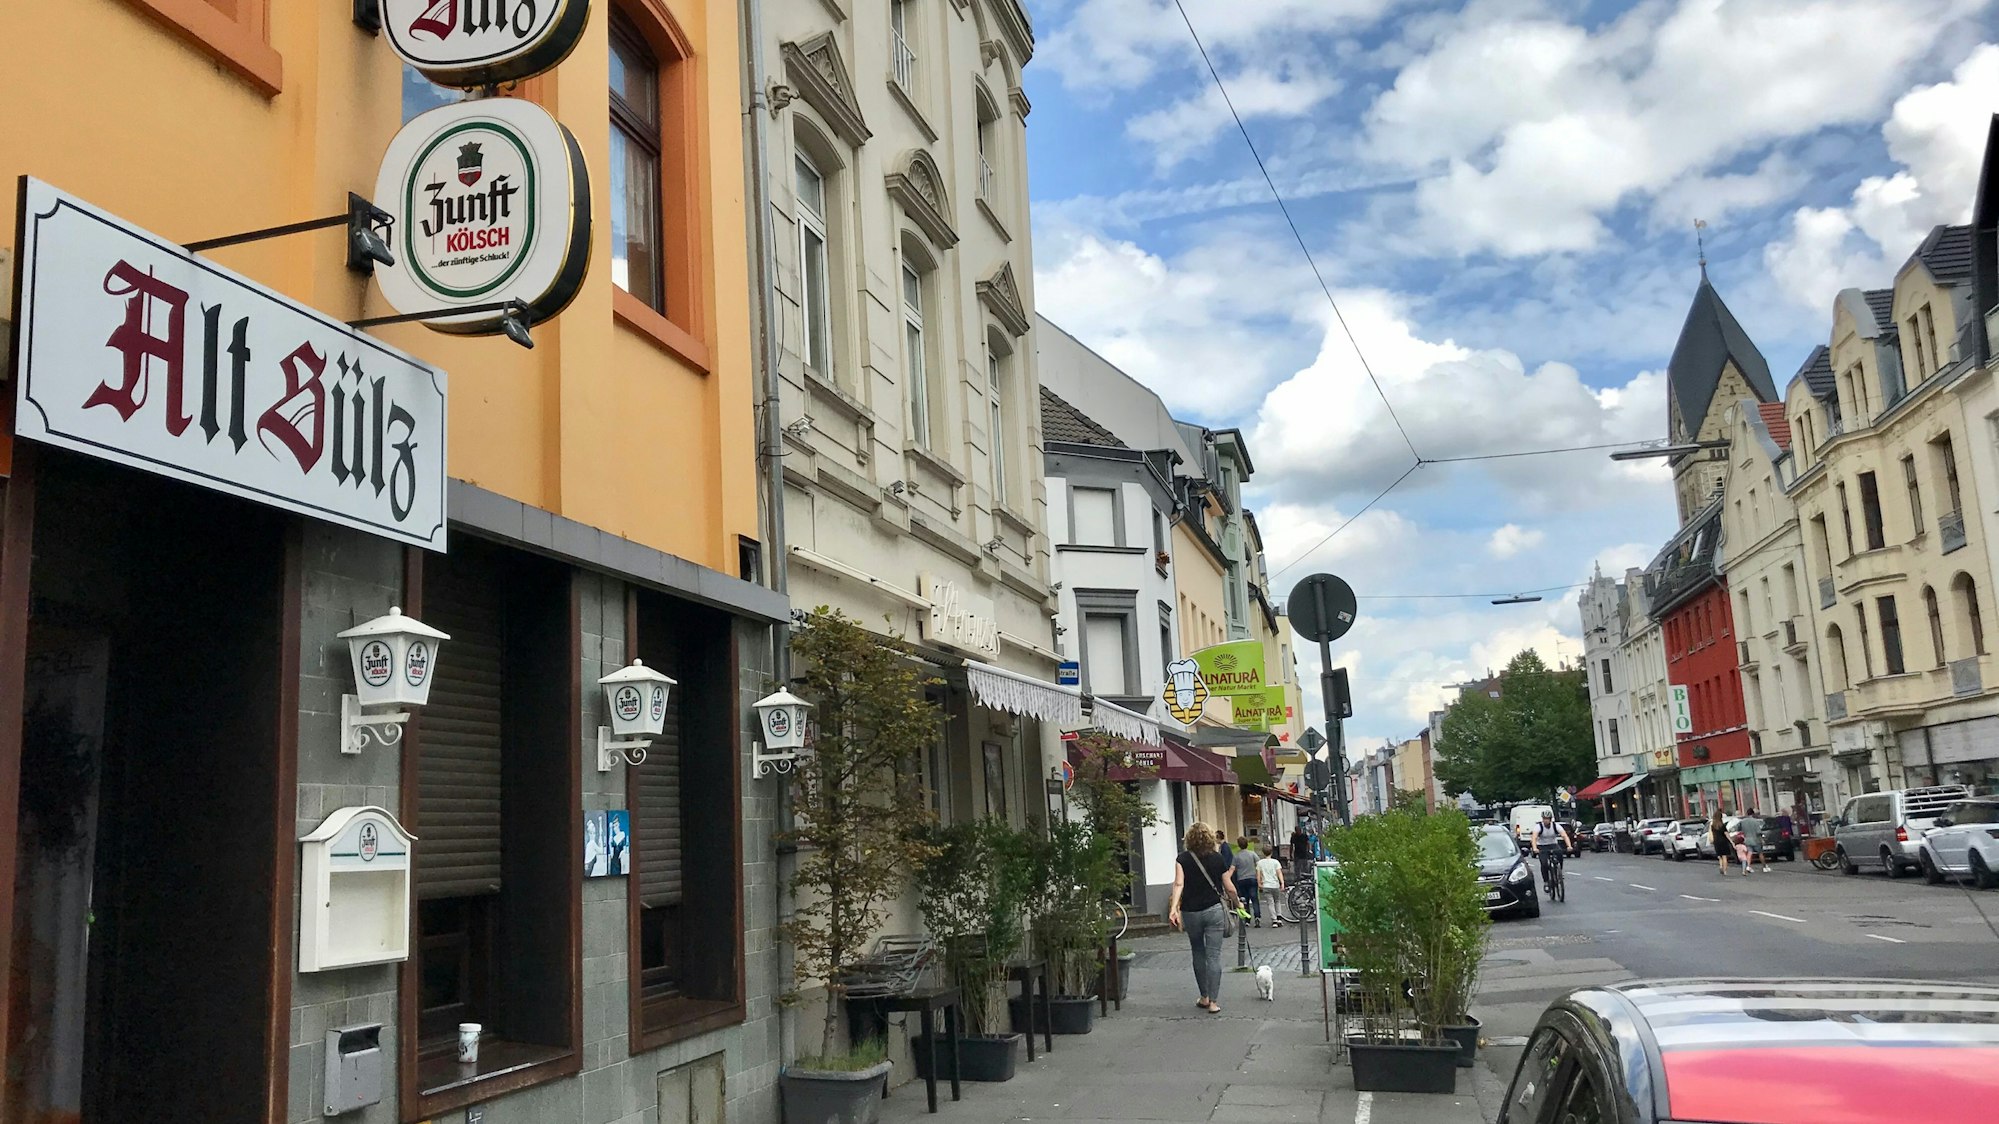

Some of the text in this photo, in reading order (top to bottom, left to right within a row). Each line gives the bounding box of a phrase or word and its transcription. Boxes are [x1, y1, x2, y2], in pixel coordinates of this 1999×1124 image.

[420, 173, 520, 238] Zunft
[447, 227, 509, 253] KÖLSCH
[450, 255, 479, 265] zünftige
[480, 251, 509, 262] Schluck!
[81, 259, 418, 522] Alt Sülz
[365, 655, 389, 671] Zunft
[1673, 688, 1690, 730] BIO
